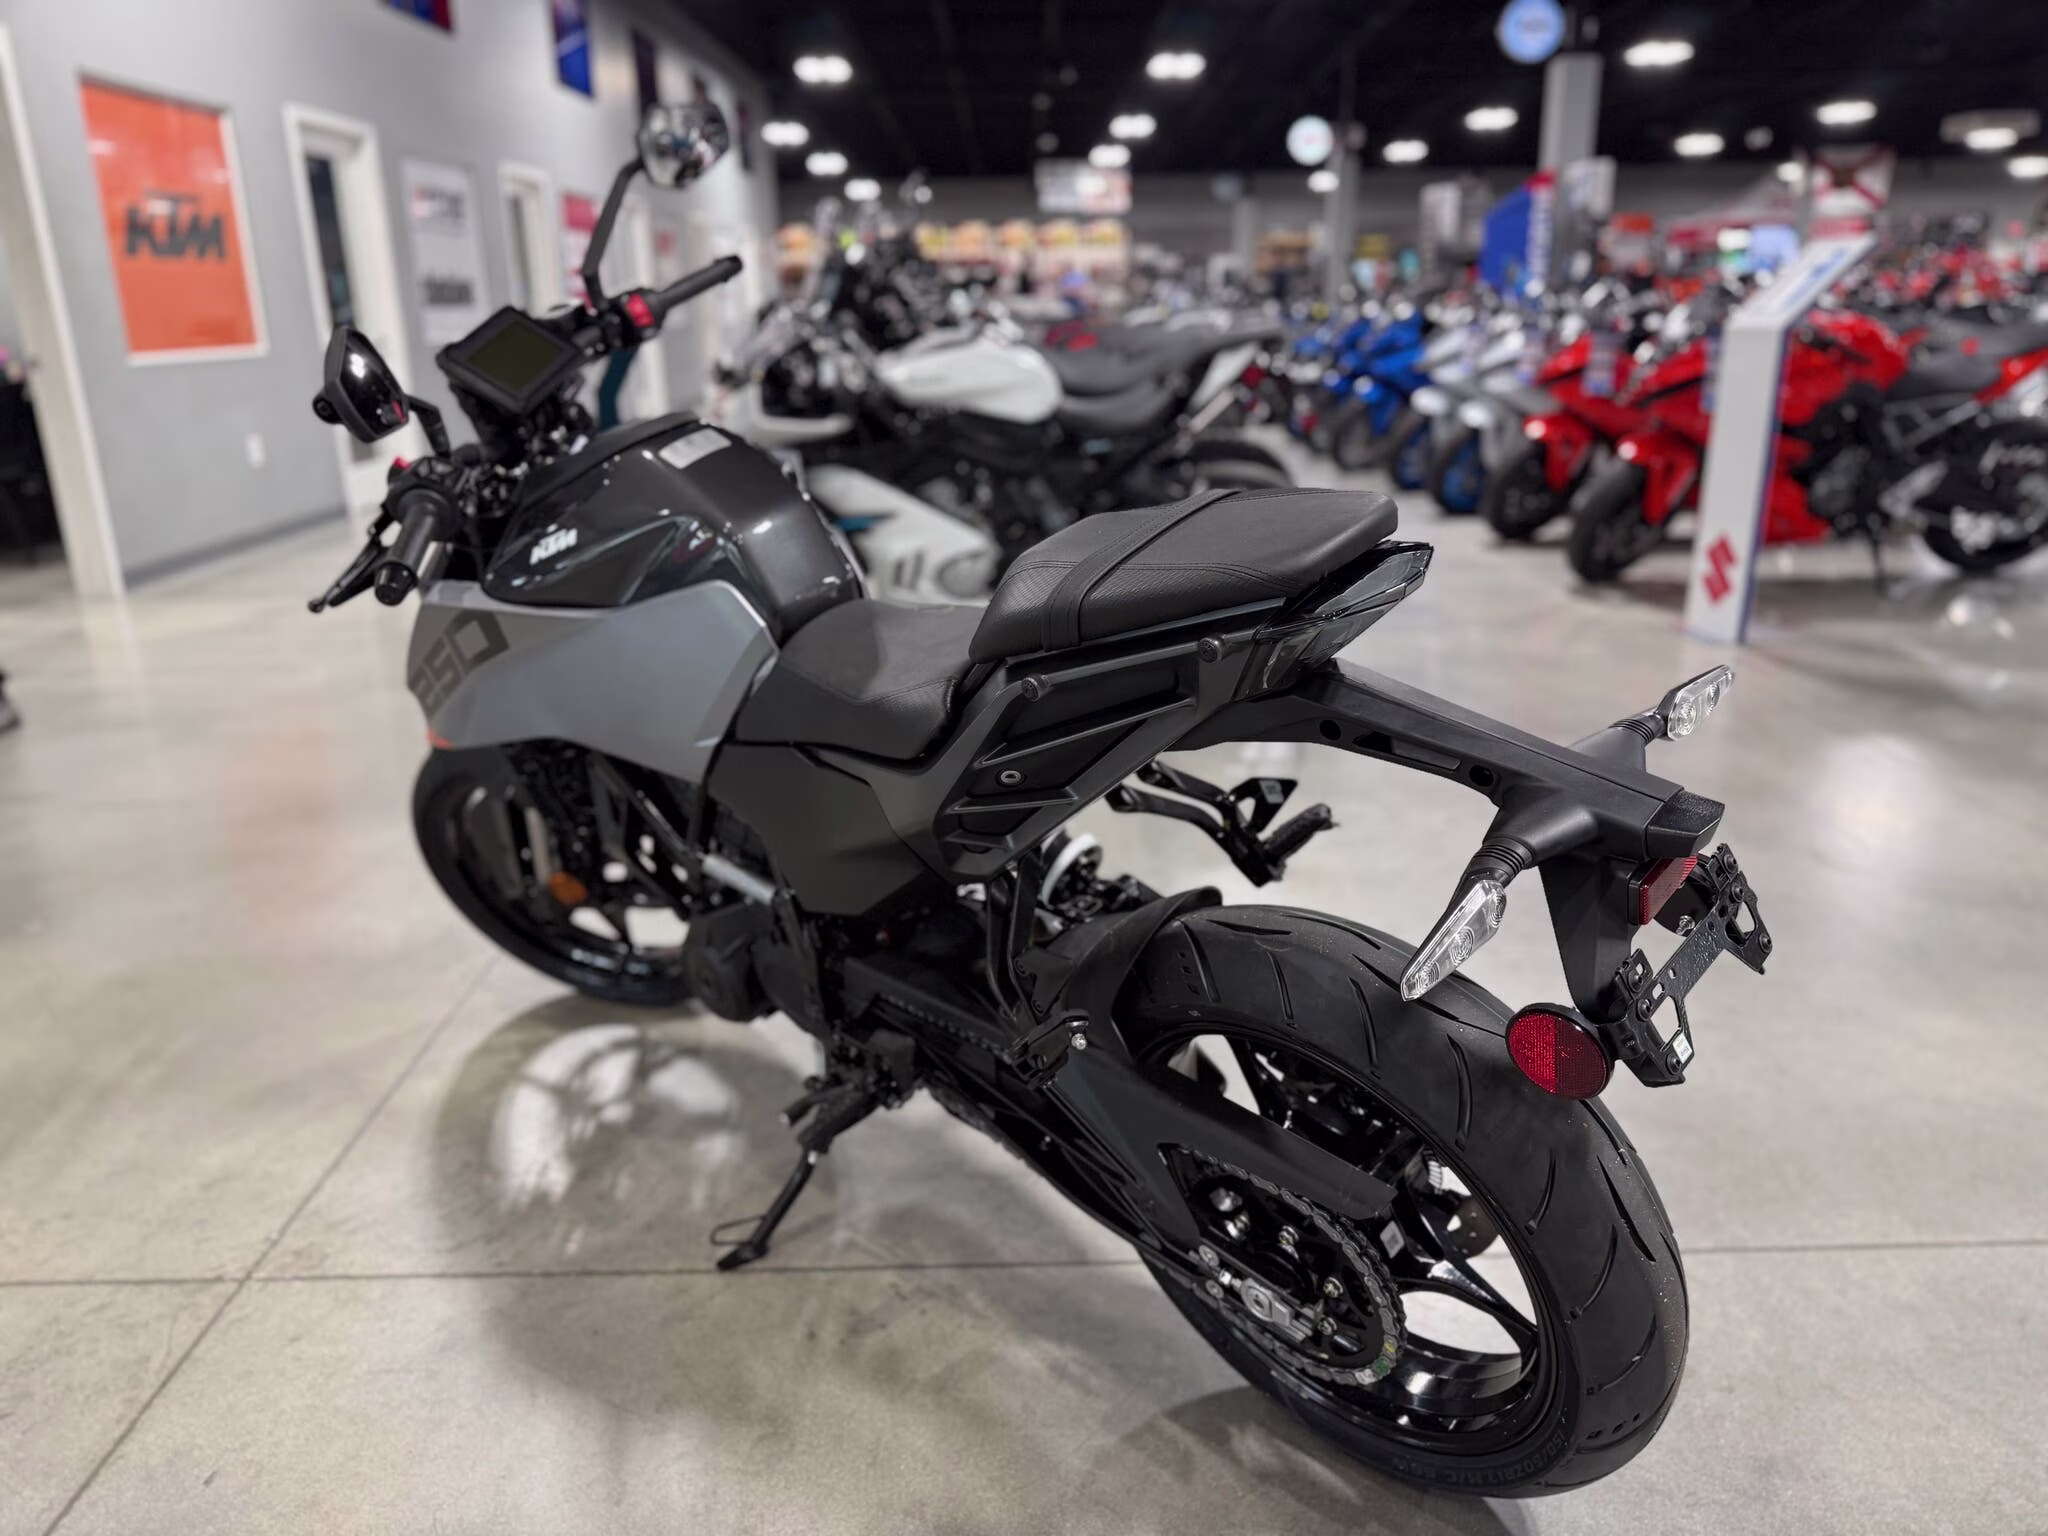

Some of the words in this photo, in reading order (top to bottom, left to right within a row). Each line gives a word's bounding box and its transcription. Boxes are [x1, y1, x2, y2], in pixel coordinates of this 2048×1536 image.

[124, 190, 226, 263] KTM
[529, 523, 579, 565] KTM
[410, 609, 509, 718] 250
